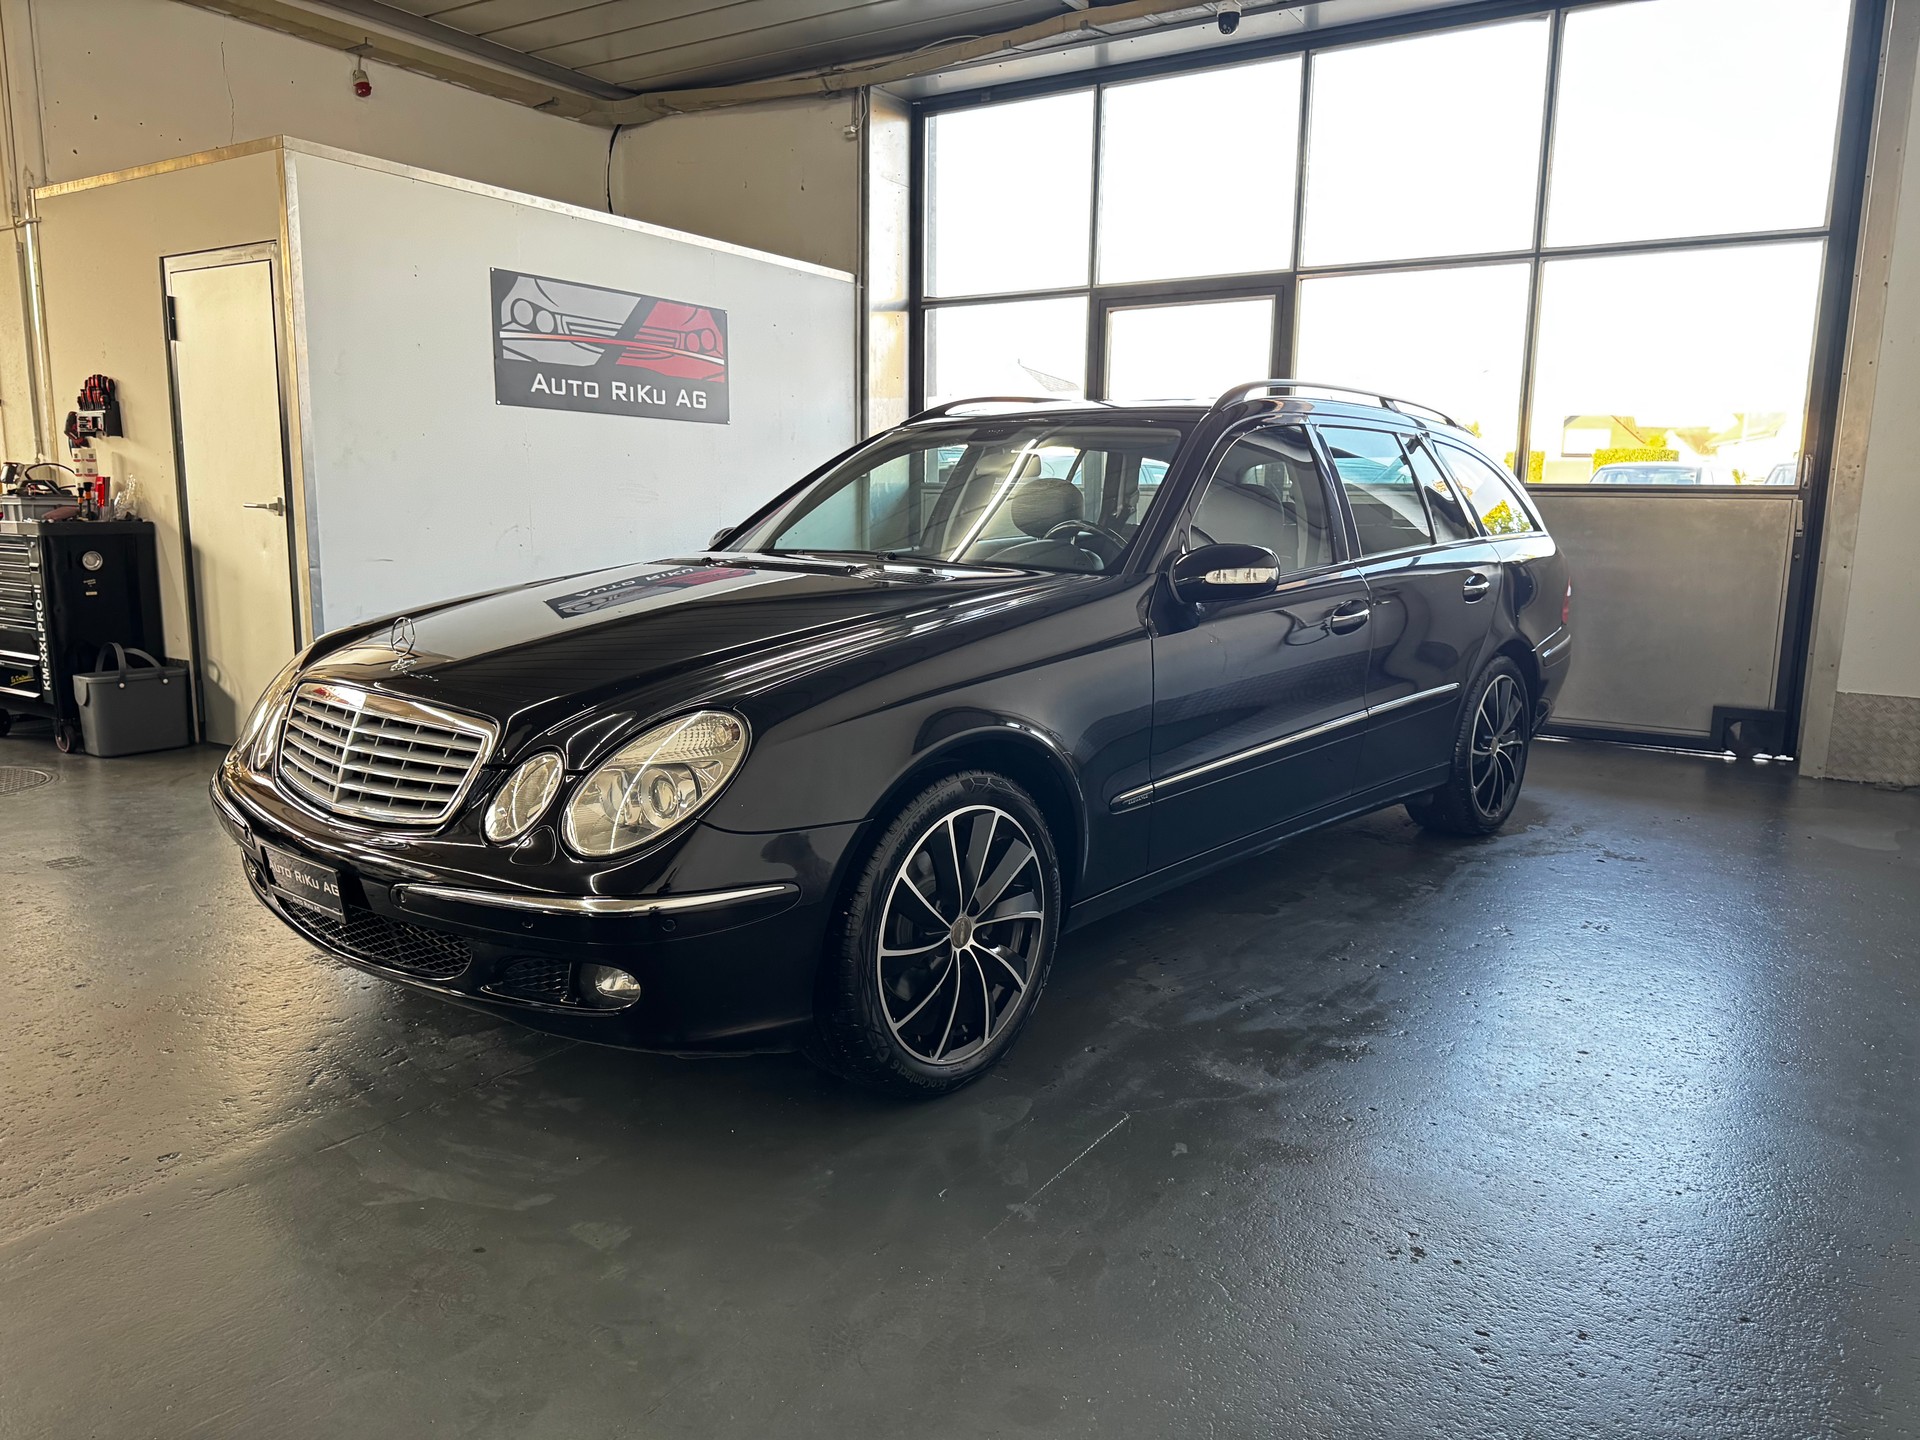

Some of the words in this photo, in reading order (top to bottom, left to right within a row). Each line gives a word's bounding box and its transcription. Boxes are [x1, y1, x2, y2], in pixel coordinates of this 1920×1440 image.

[530, 373, 599, 398] AUTO
[675, 389, 707, 409] AG
[323, 881, 340, 896] AG
